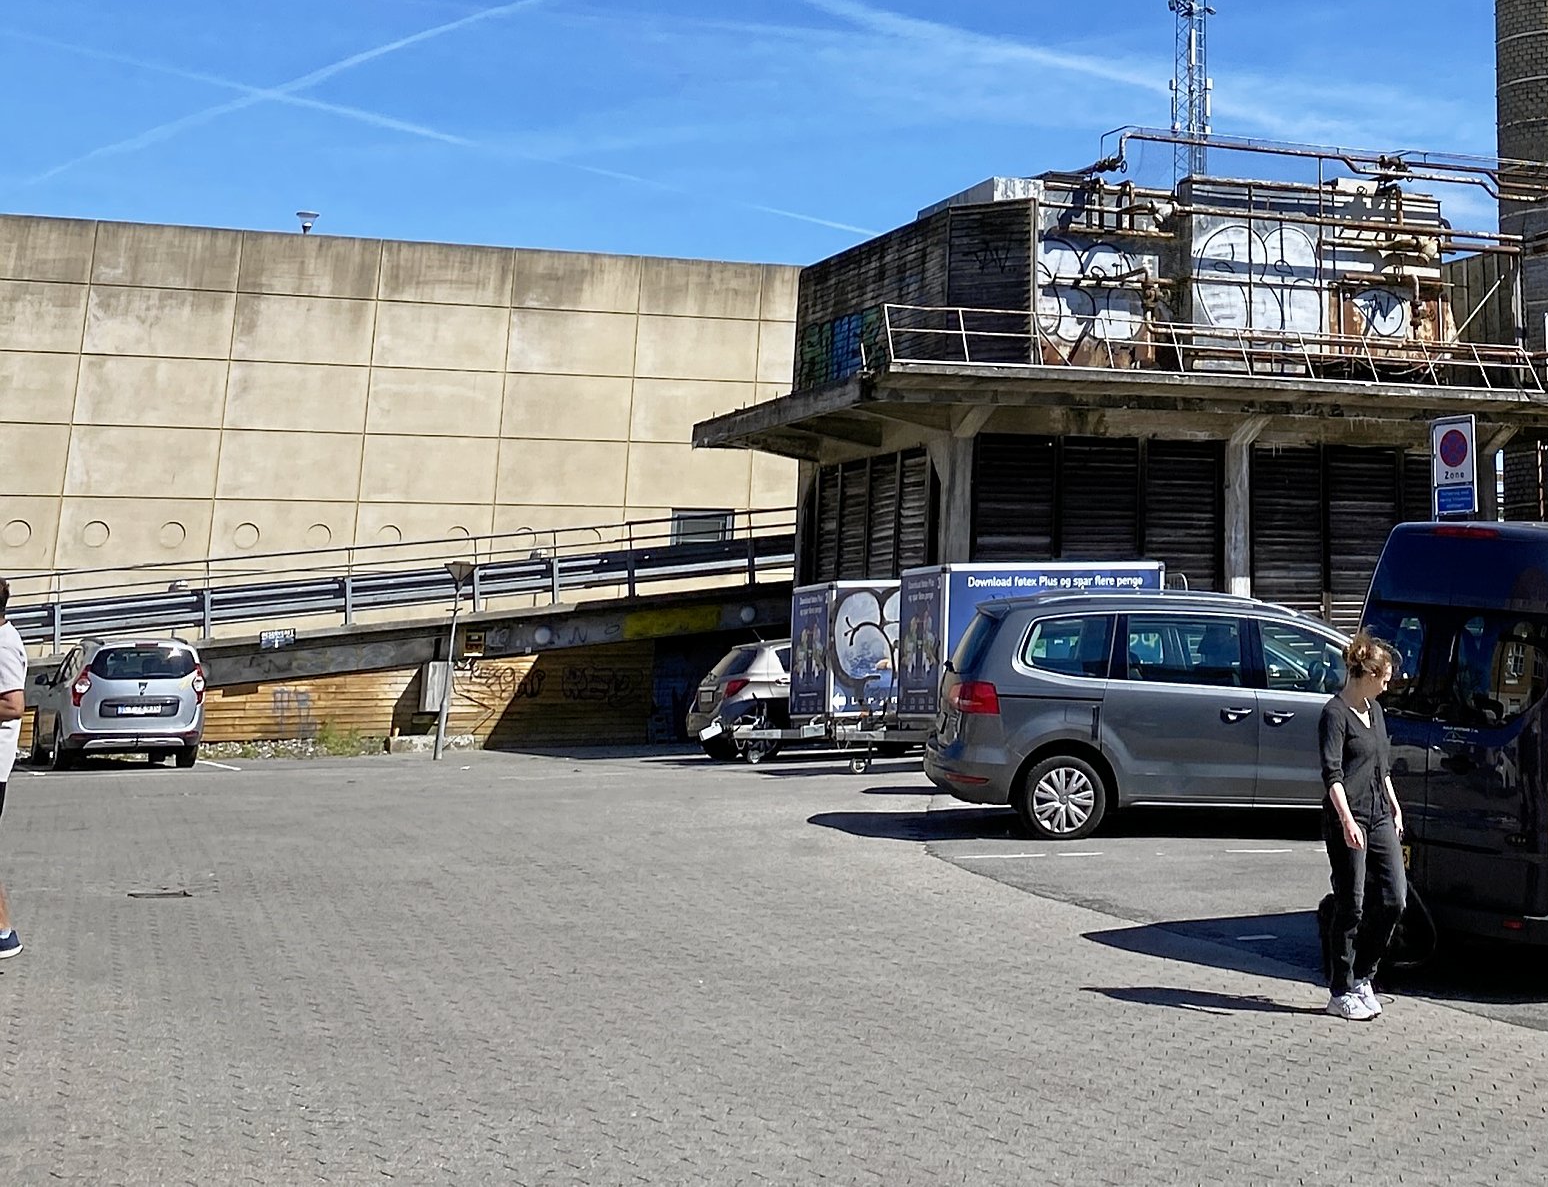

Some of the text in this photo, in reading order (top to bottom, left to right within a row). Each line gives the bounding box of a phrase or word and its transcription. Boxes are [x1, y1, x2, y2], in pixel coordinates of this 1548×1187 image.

[1444, 470, 1465, 480] Zone
[967, 575, 1144, 589] Download føtex Plus og spar flere penge
